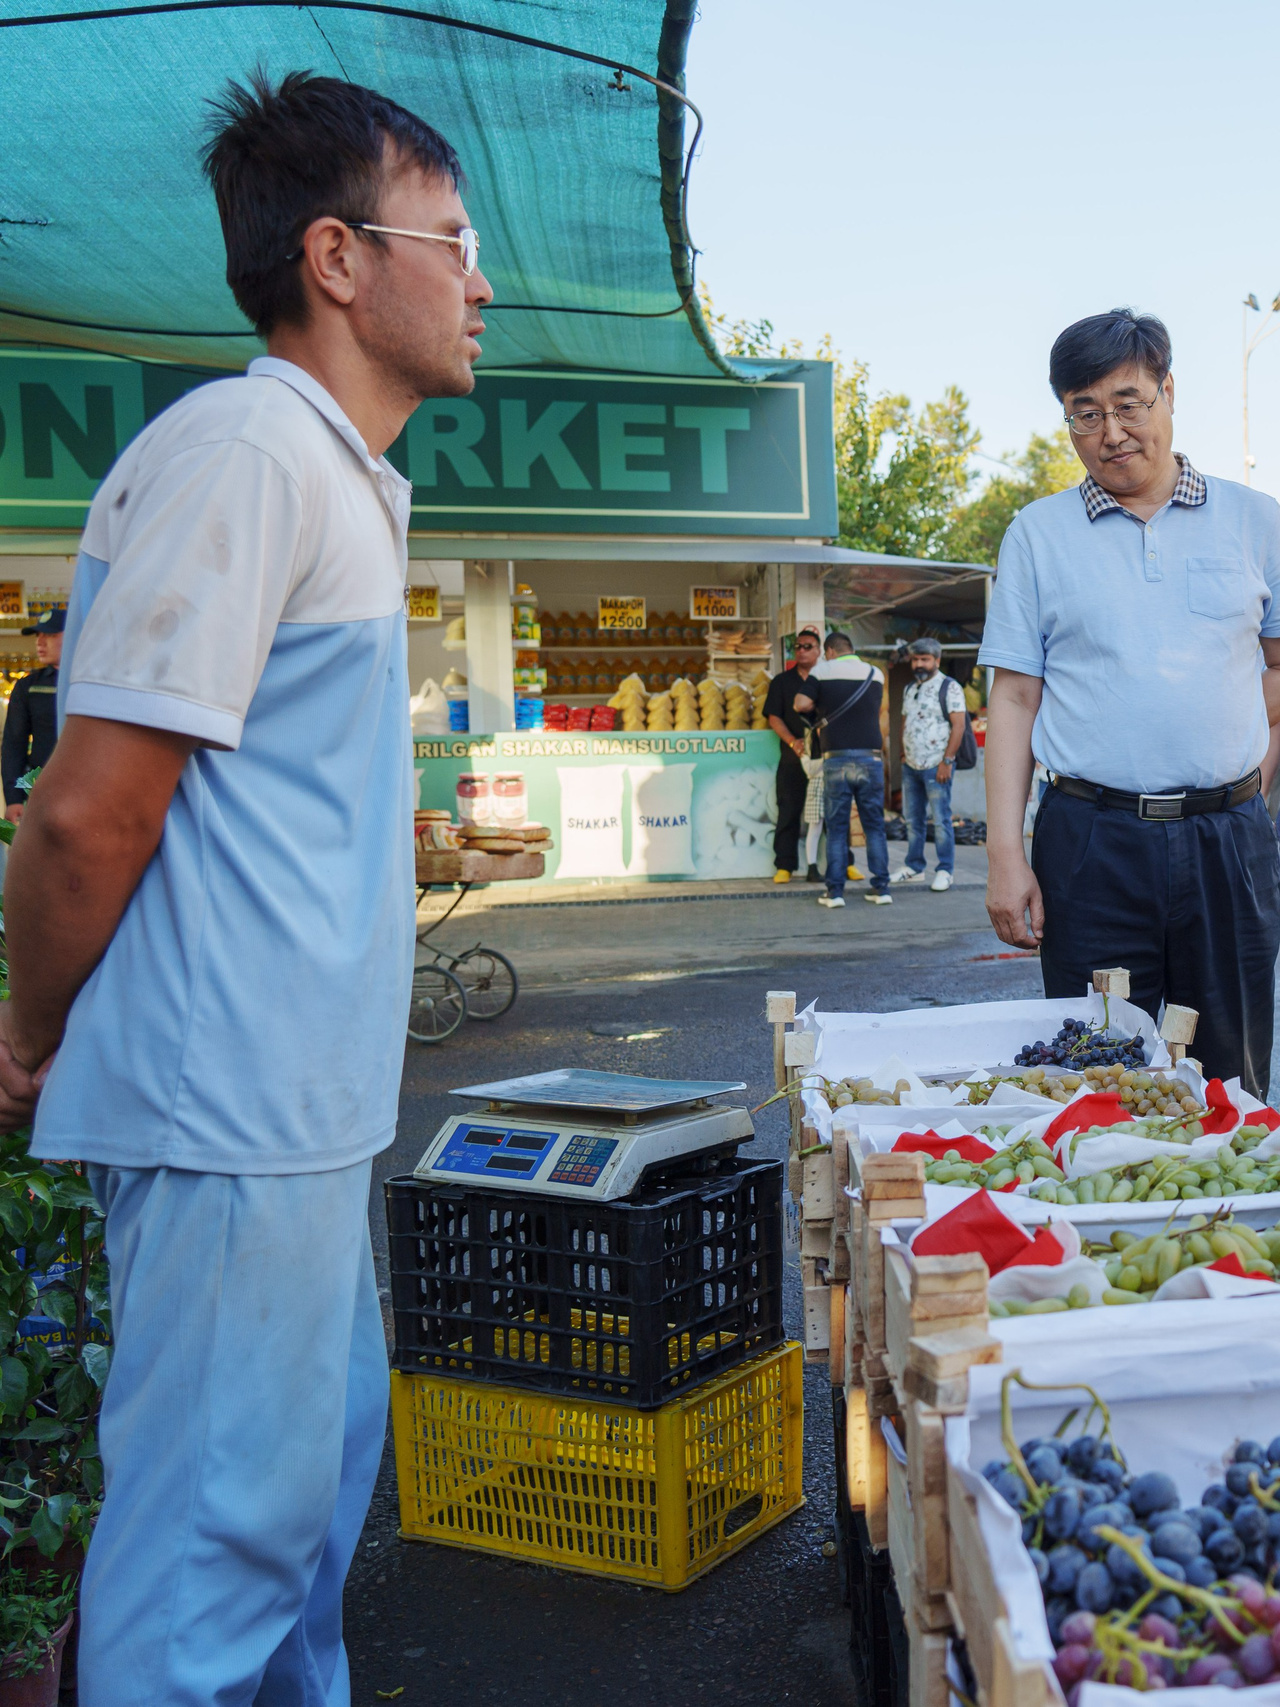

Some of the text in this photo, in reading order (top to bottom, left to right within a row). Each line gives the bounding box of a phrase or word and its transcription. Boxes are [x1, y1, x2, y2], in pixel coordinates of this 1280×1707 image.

[0, 382, 751, 494] N RKET
[600, 598, 643, 609] МАКАРОН
[696, 605, 735, 617] 11000
[601, 616, 643, 628] 12500
[502, 739, 588, 756] SHAKAR
[592, 738, 745, 755] MAHSULOTLARI
[568, 817, 619, 829] SHAKAR
[638, 814, 688, 828] SHAKAR
